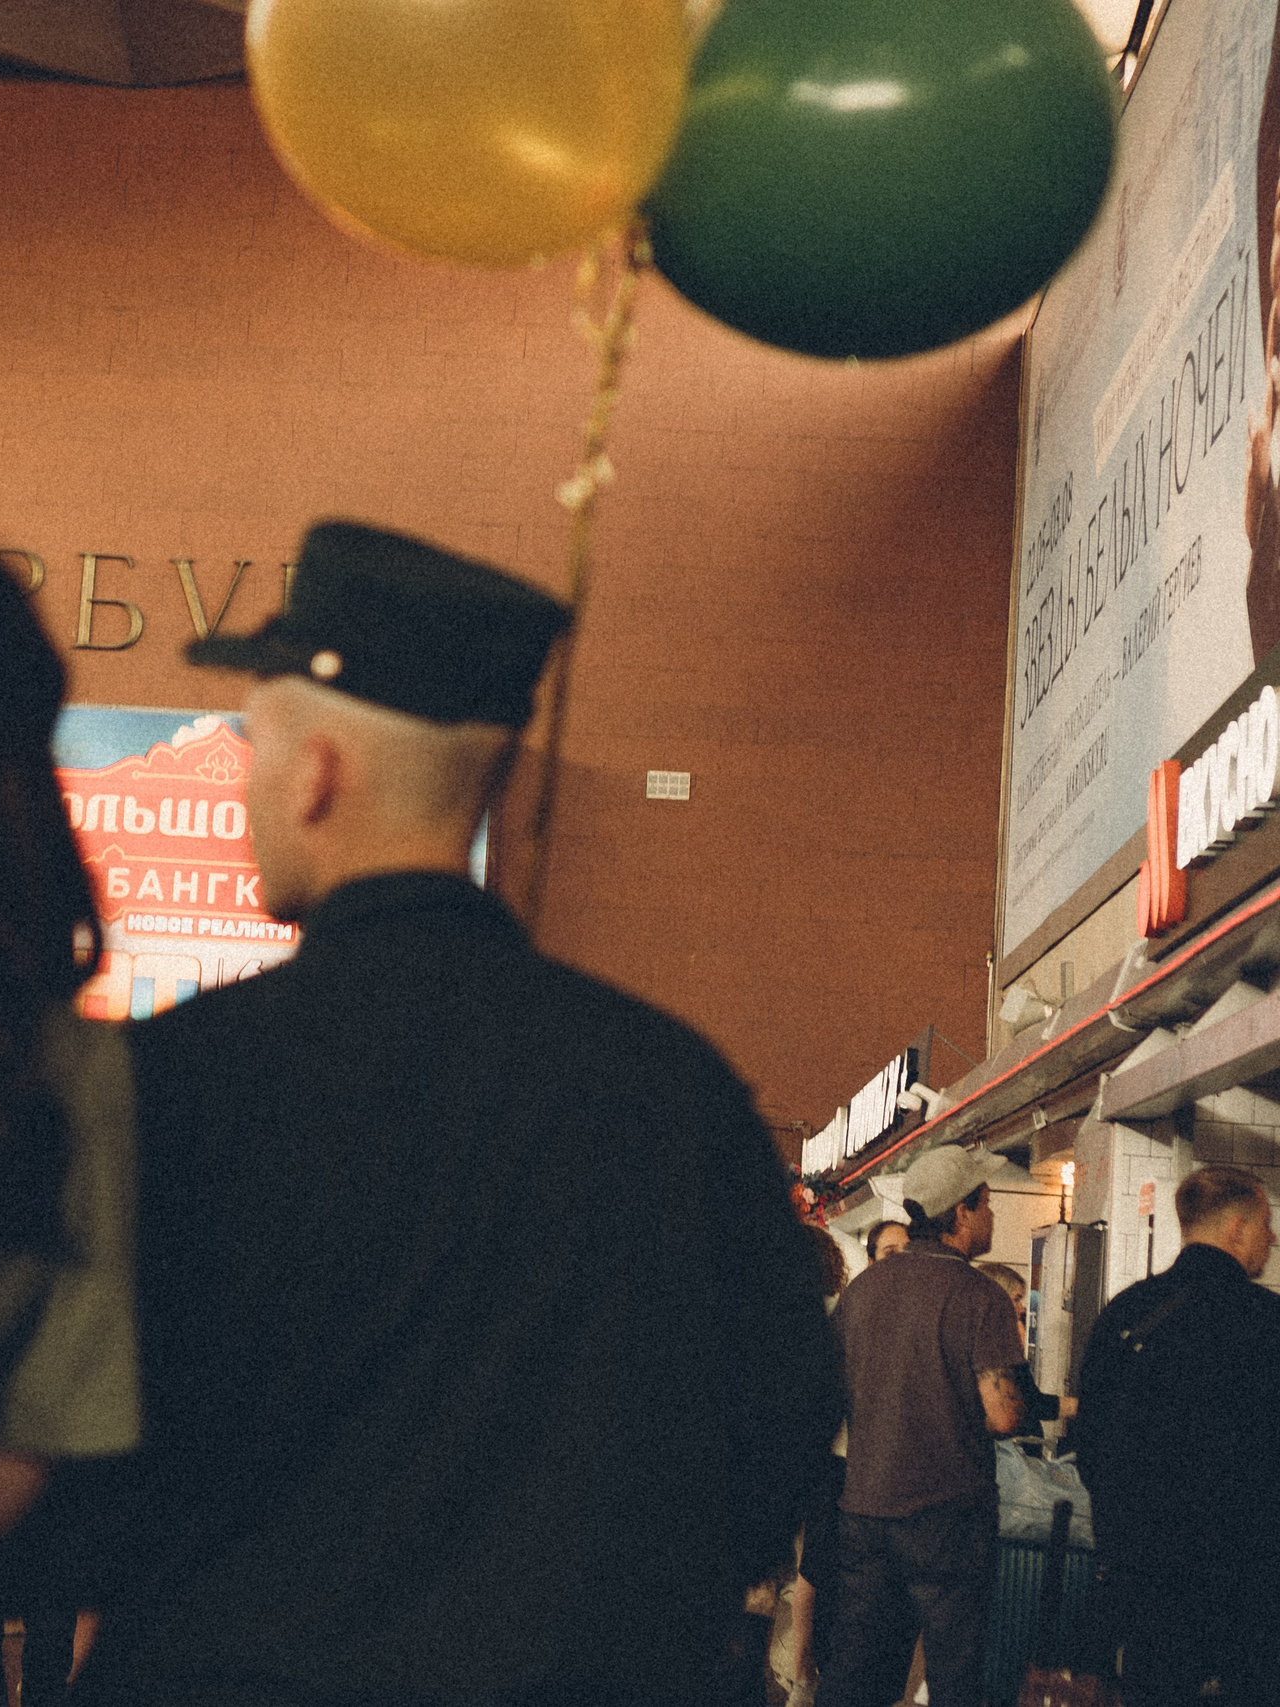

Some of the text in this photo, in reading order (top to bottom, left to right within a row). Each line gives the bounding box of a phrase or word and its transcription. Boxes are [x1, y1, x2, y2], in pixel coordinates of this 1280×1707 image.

[1020, 535, 1081, 732] ЗВЕЗДЫ
[1083, 417, 1151, 636] БЕЛЫХ
[1156, 243, 1250, 528] НОЧЕЙ
[1121, 584, 1160, 682] ВАЛЕРИЙ
[1162, 531, 1202, 628] ГЕРГИЕВ
[107, 867, 260, 907] БАНГК
[127, 914, 293, 940] НОВОЕ РЕАЛИТИ
